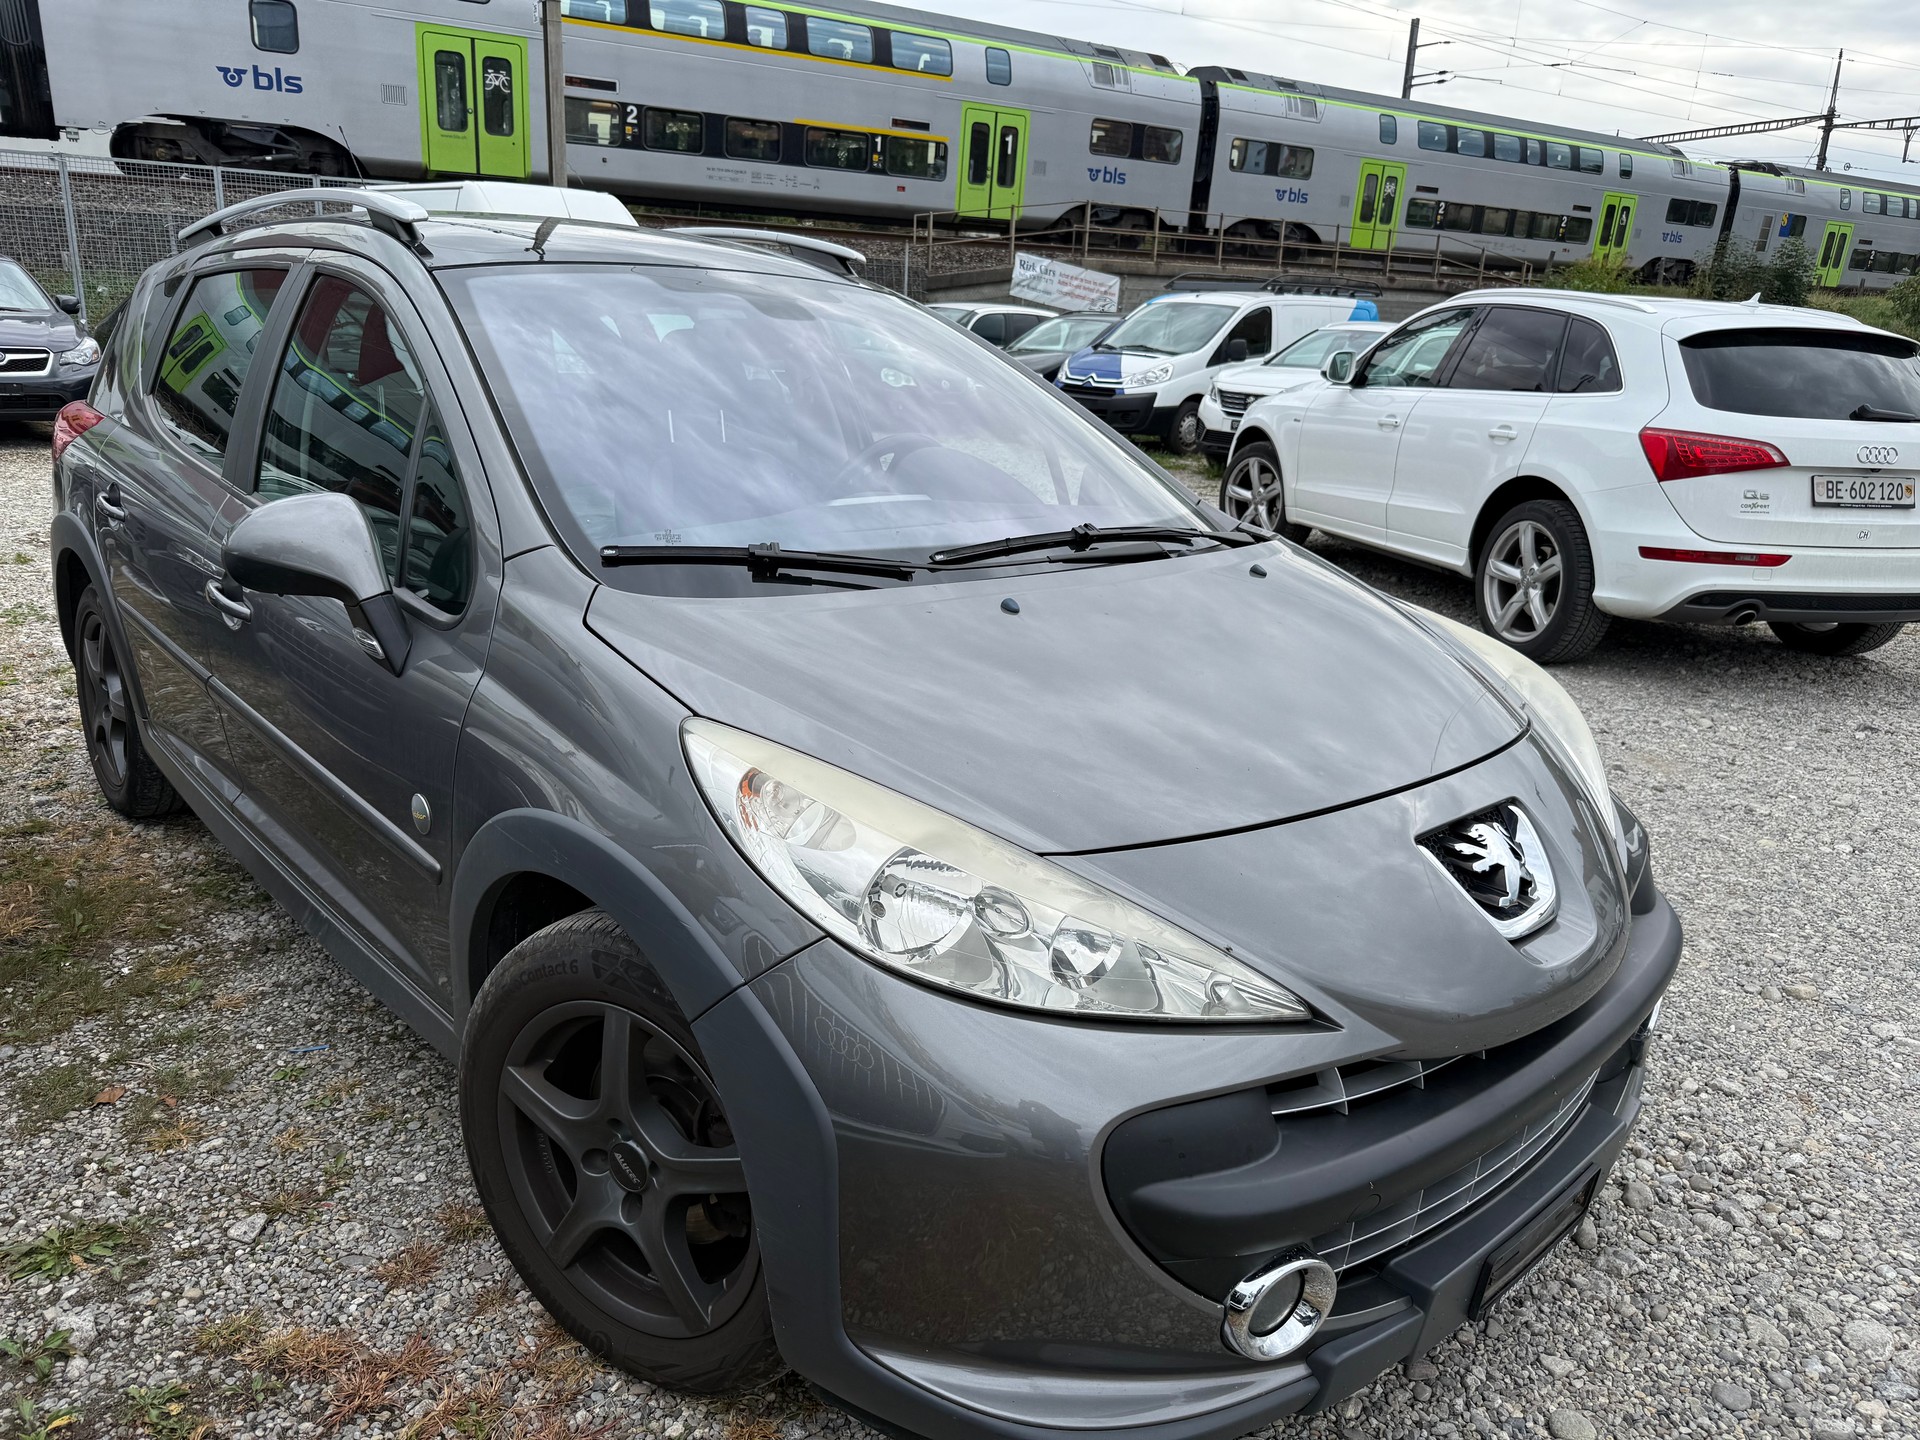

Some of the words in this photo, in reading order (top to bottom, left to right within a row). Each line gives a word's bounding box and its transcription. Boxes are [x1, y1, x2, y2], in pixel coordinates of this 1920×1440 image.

[252, 64, 303, 94] bls
[626, 105, 638, 124] 2
[874, 135, 882, 153] 1
[1005, 134, 1013, 155] 1
[1103, 166, 1126, 185] bls
[1288, 187, 1309, 204] bls
[1438, 201, 1446, 214] 2
[1561, 215, 1568, 228] 2
[1669, 230, 1683, 244] bls
[1858, 530, 1869, 539] CH
[569, 959, 579, 975] 6
